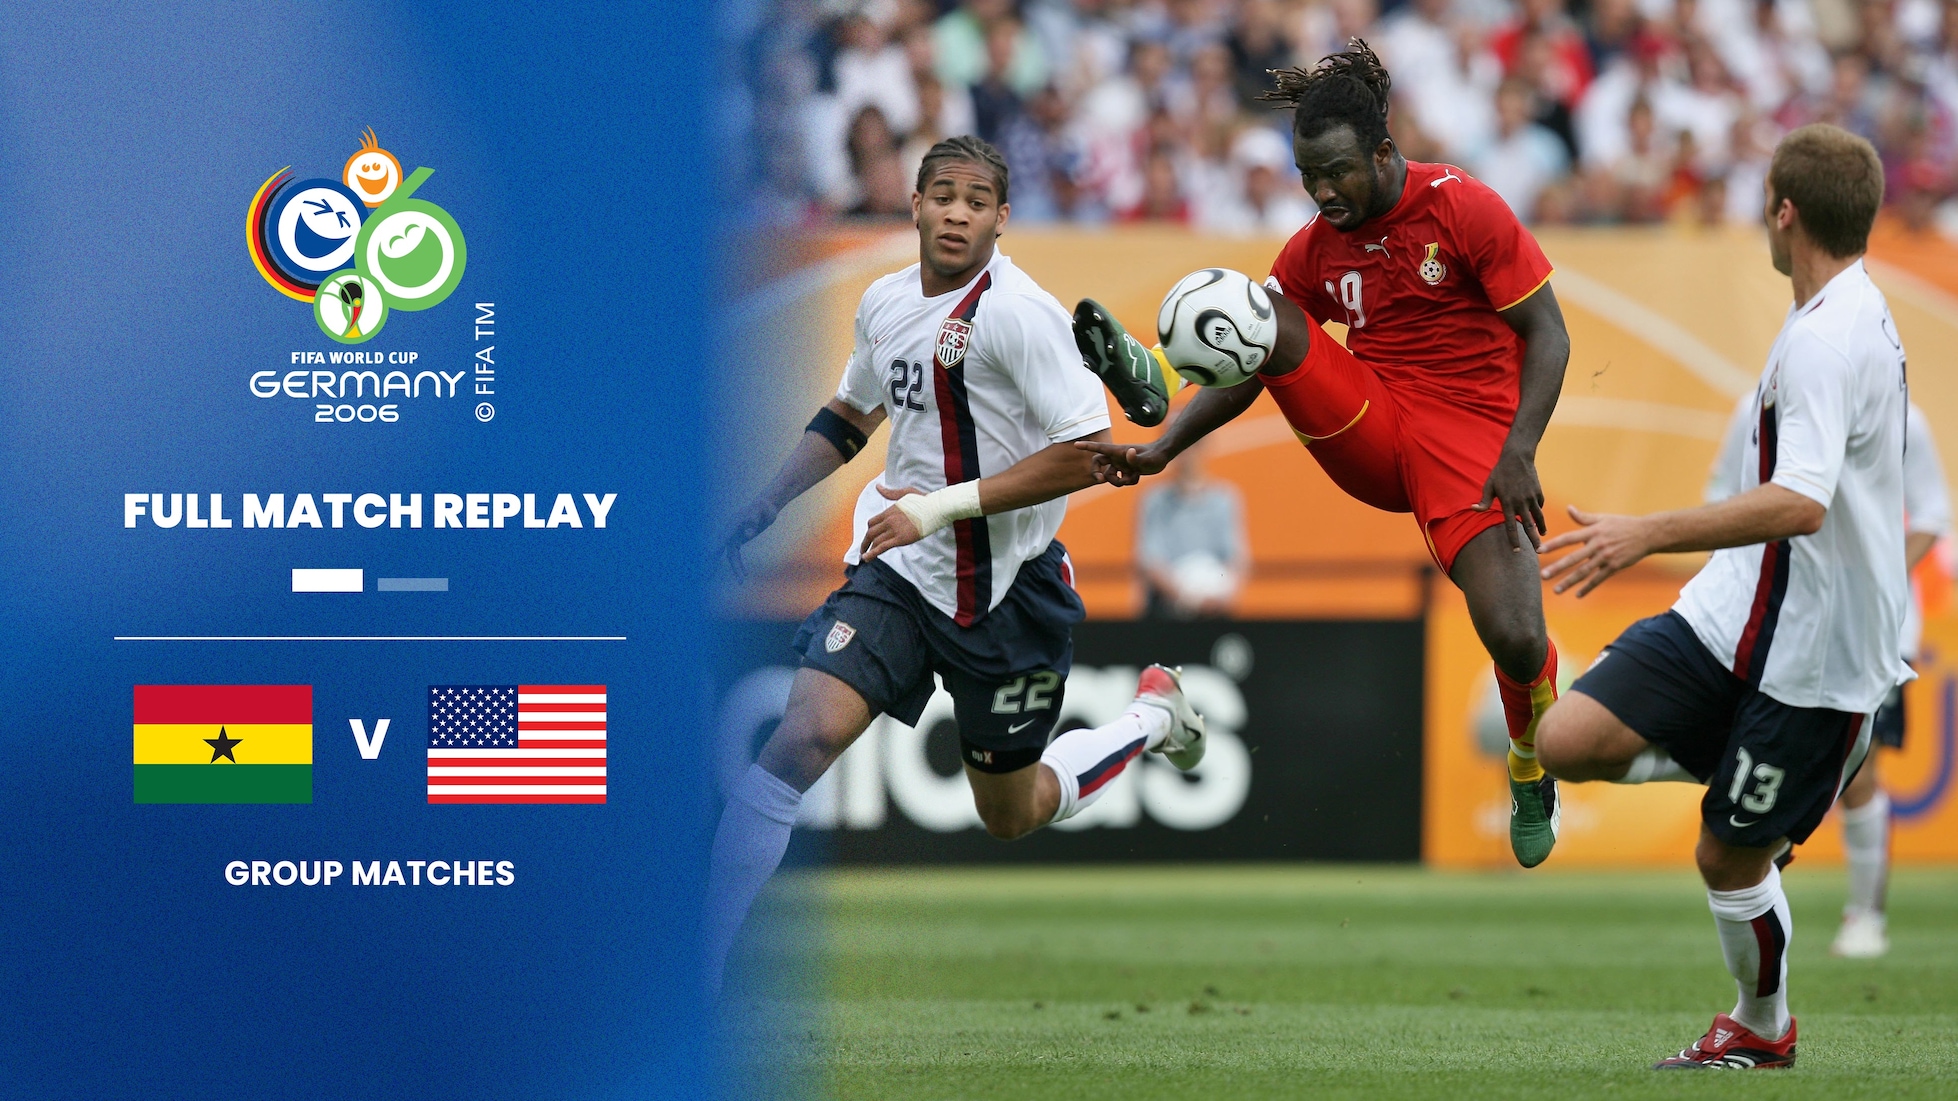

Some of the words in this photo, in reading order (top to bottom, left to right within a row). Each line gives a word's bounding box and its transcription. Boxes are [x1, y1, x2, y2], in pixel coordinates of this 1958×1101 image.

[889, 356, 928, 413] 22
[991, 671, 1061, 714] 22
[1728, 746, 1786, 814] 13
